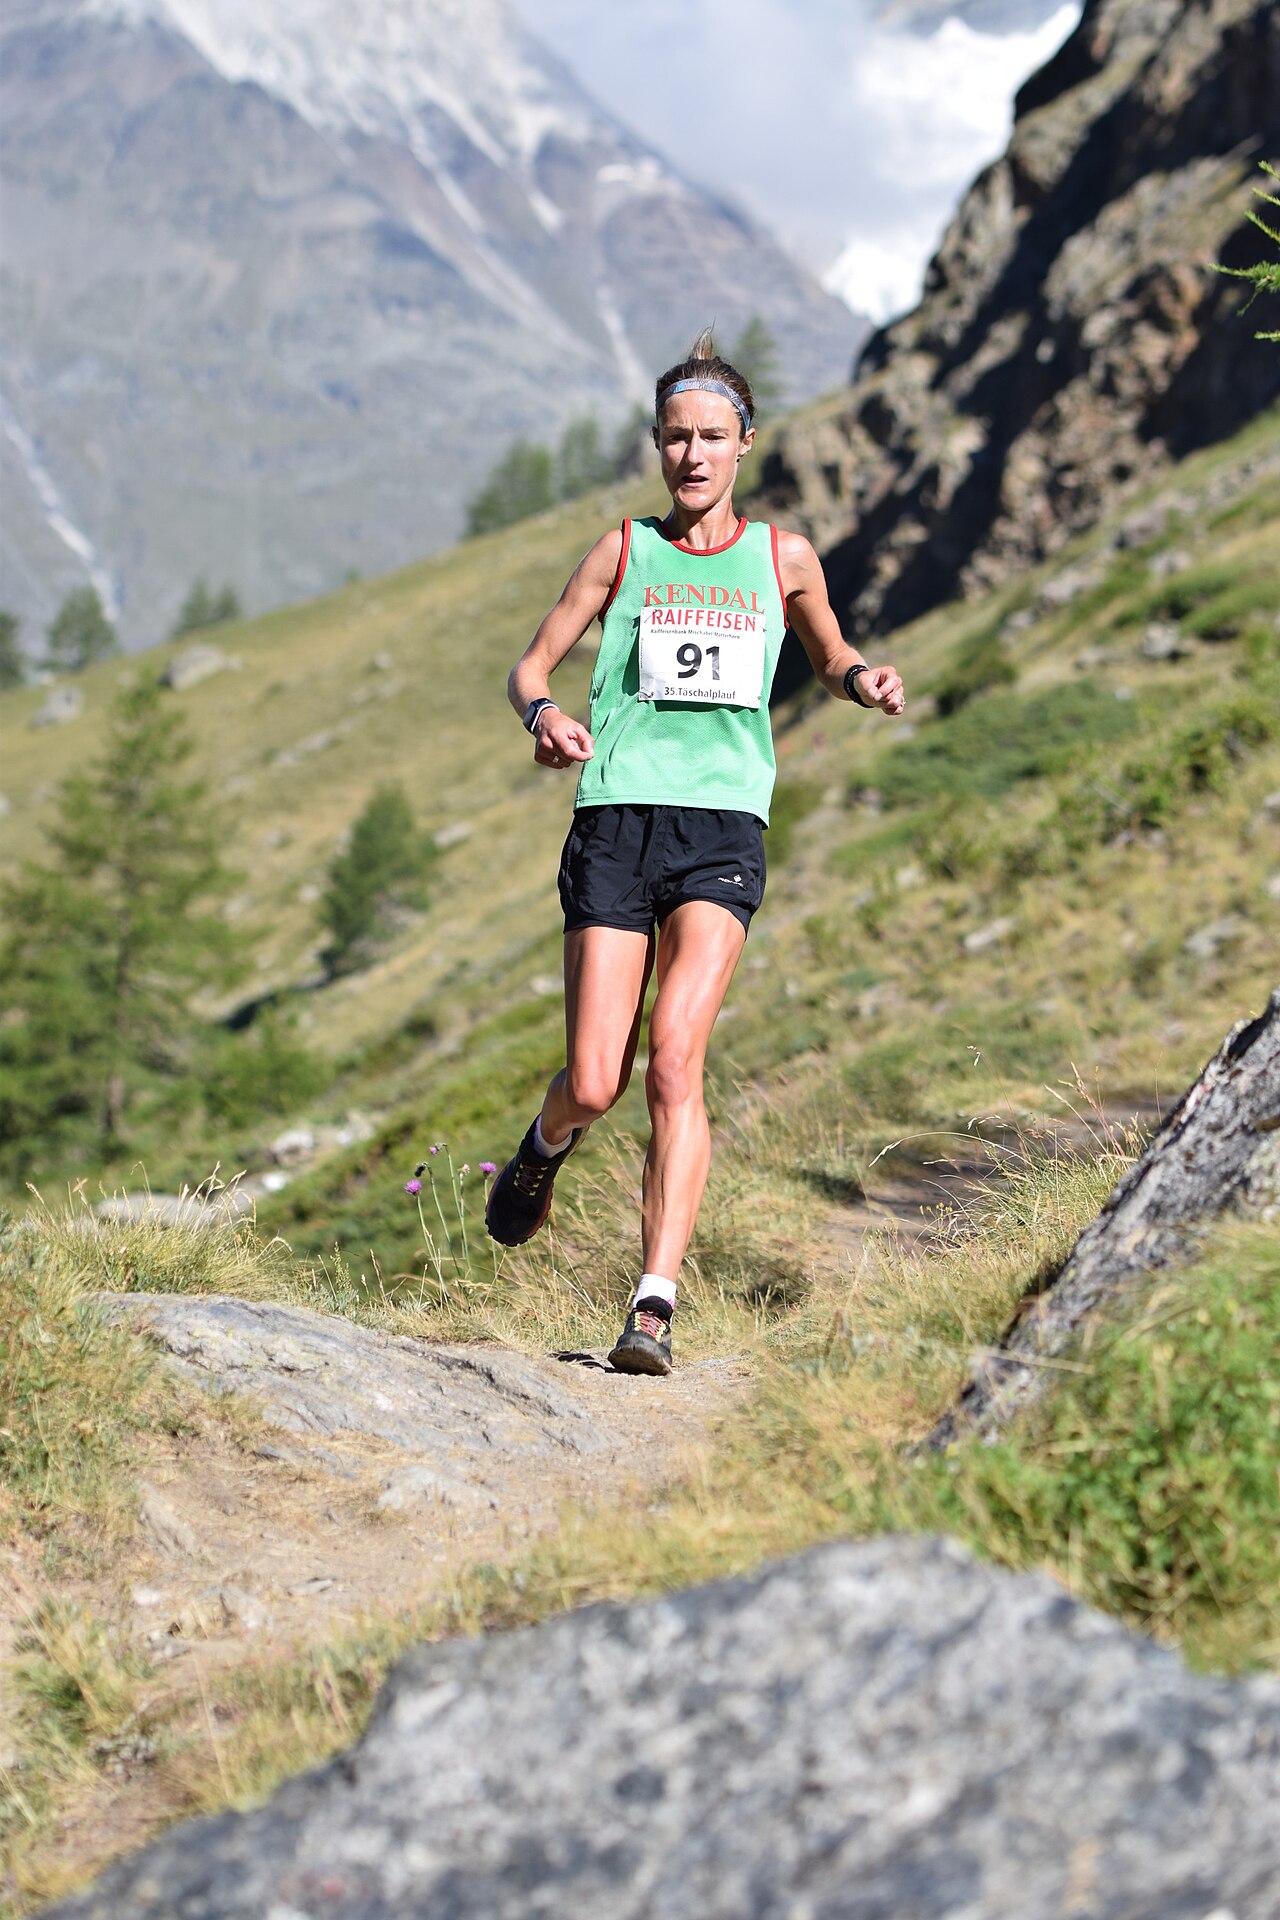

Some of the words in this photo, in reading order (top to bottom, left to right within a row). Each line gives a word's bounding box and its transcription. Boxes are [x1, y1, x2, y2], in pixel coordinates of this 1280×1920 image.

[644, 583, 765, 615] KENDAL
[651, 609, 756, 632] RAIFFEISEN
[676, 643, 720, 680] 91
